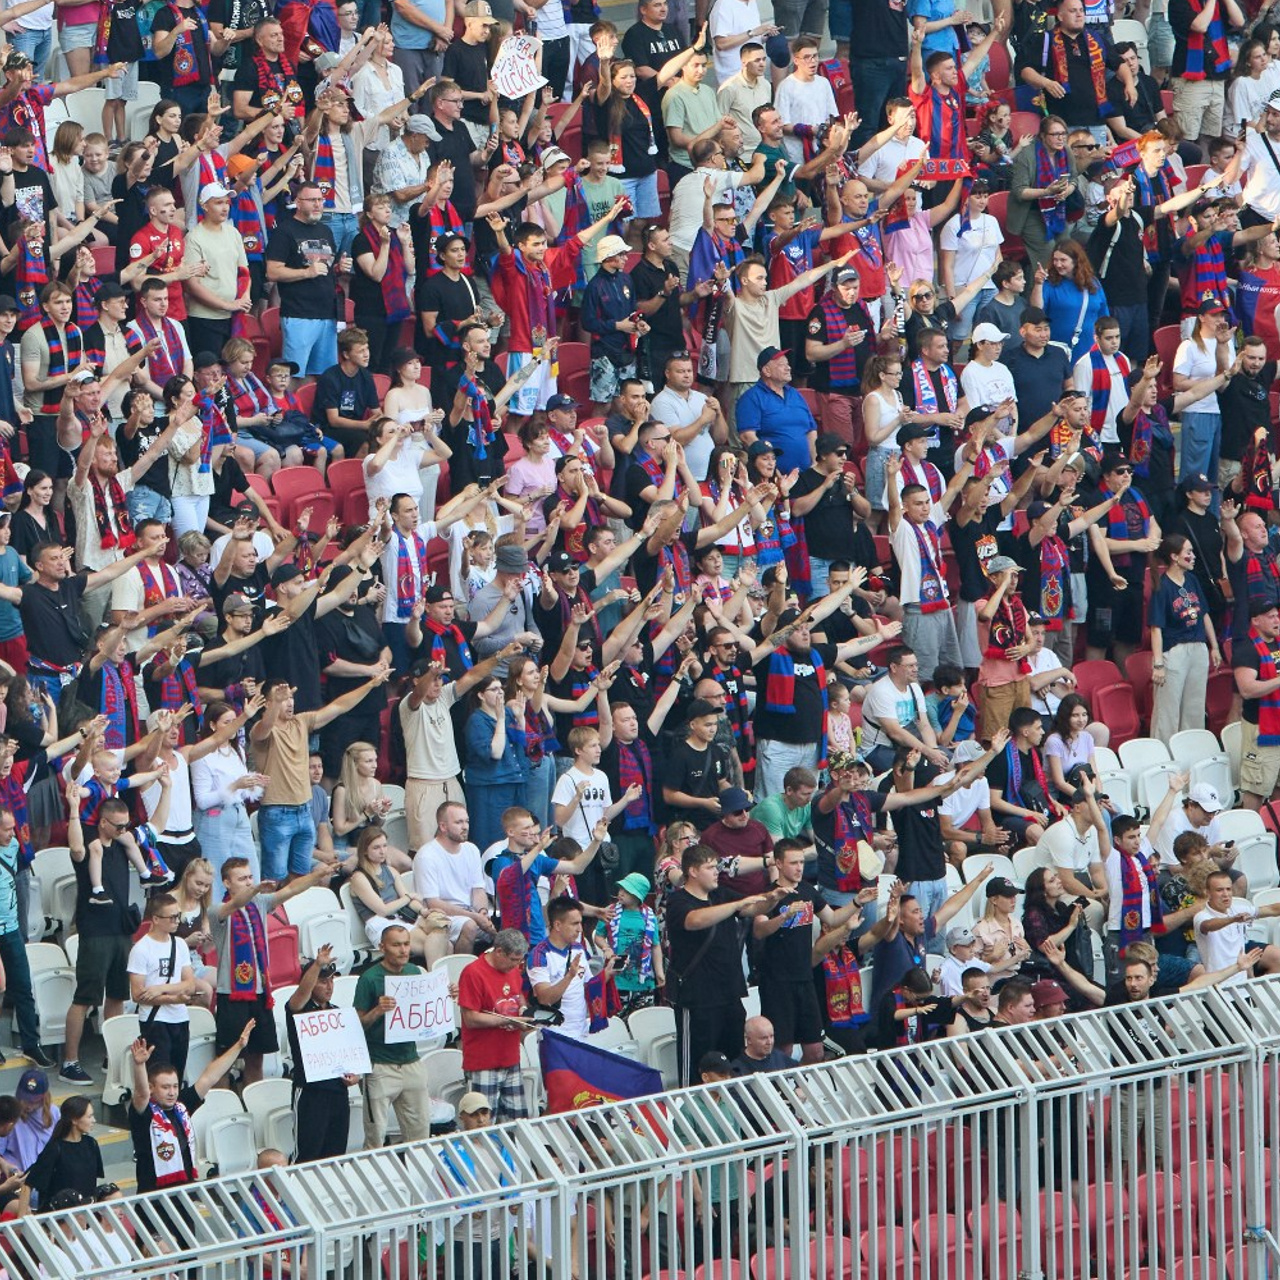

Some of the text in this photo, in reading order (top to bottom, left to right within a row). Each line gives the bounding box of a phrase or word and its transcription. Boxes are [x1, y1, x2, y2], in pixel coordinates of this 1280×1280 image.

[500, 65, 541, 96] ЦСКА
[299, 1013, 345, 1039] АББОС
[389, 995, 453, 1031] АББОС
